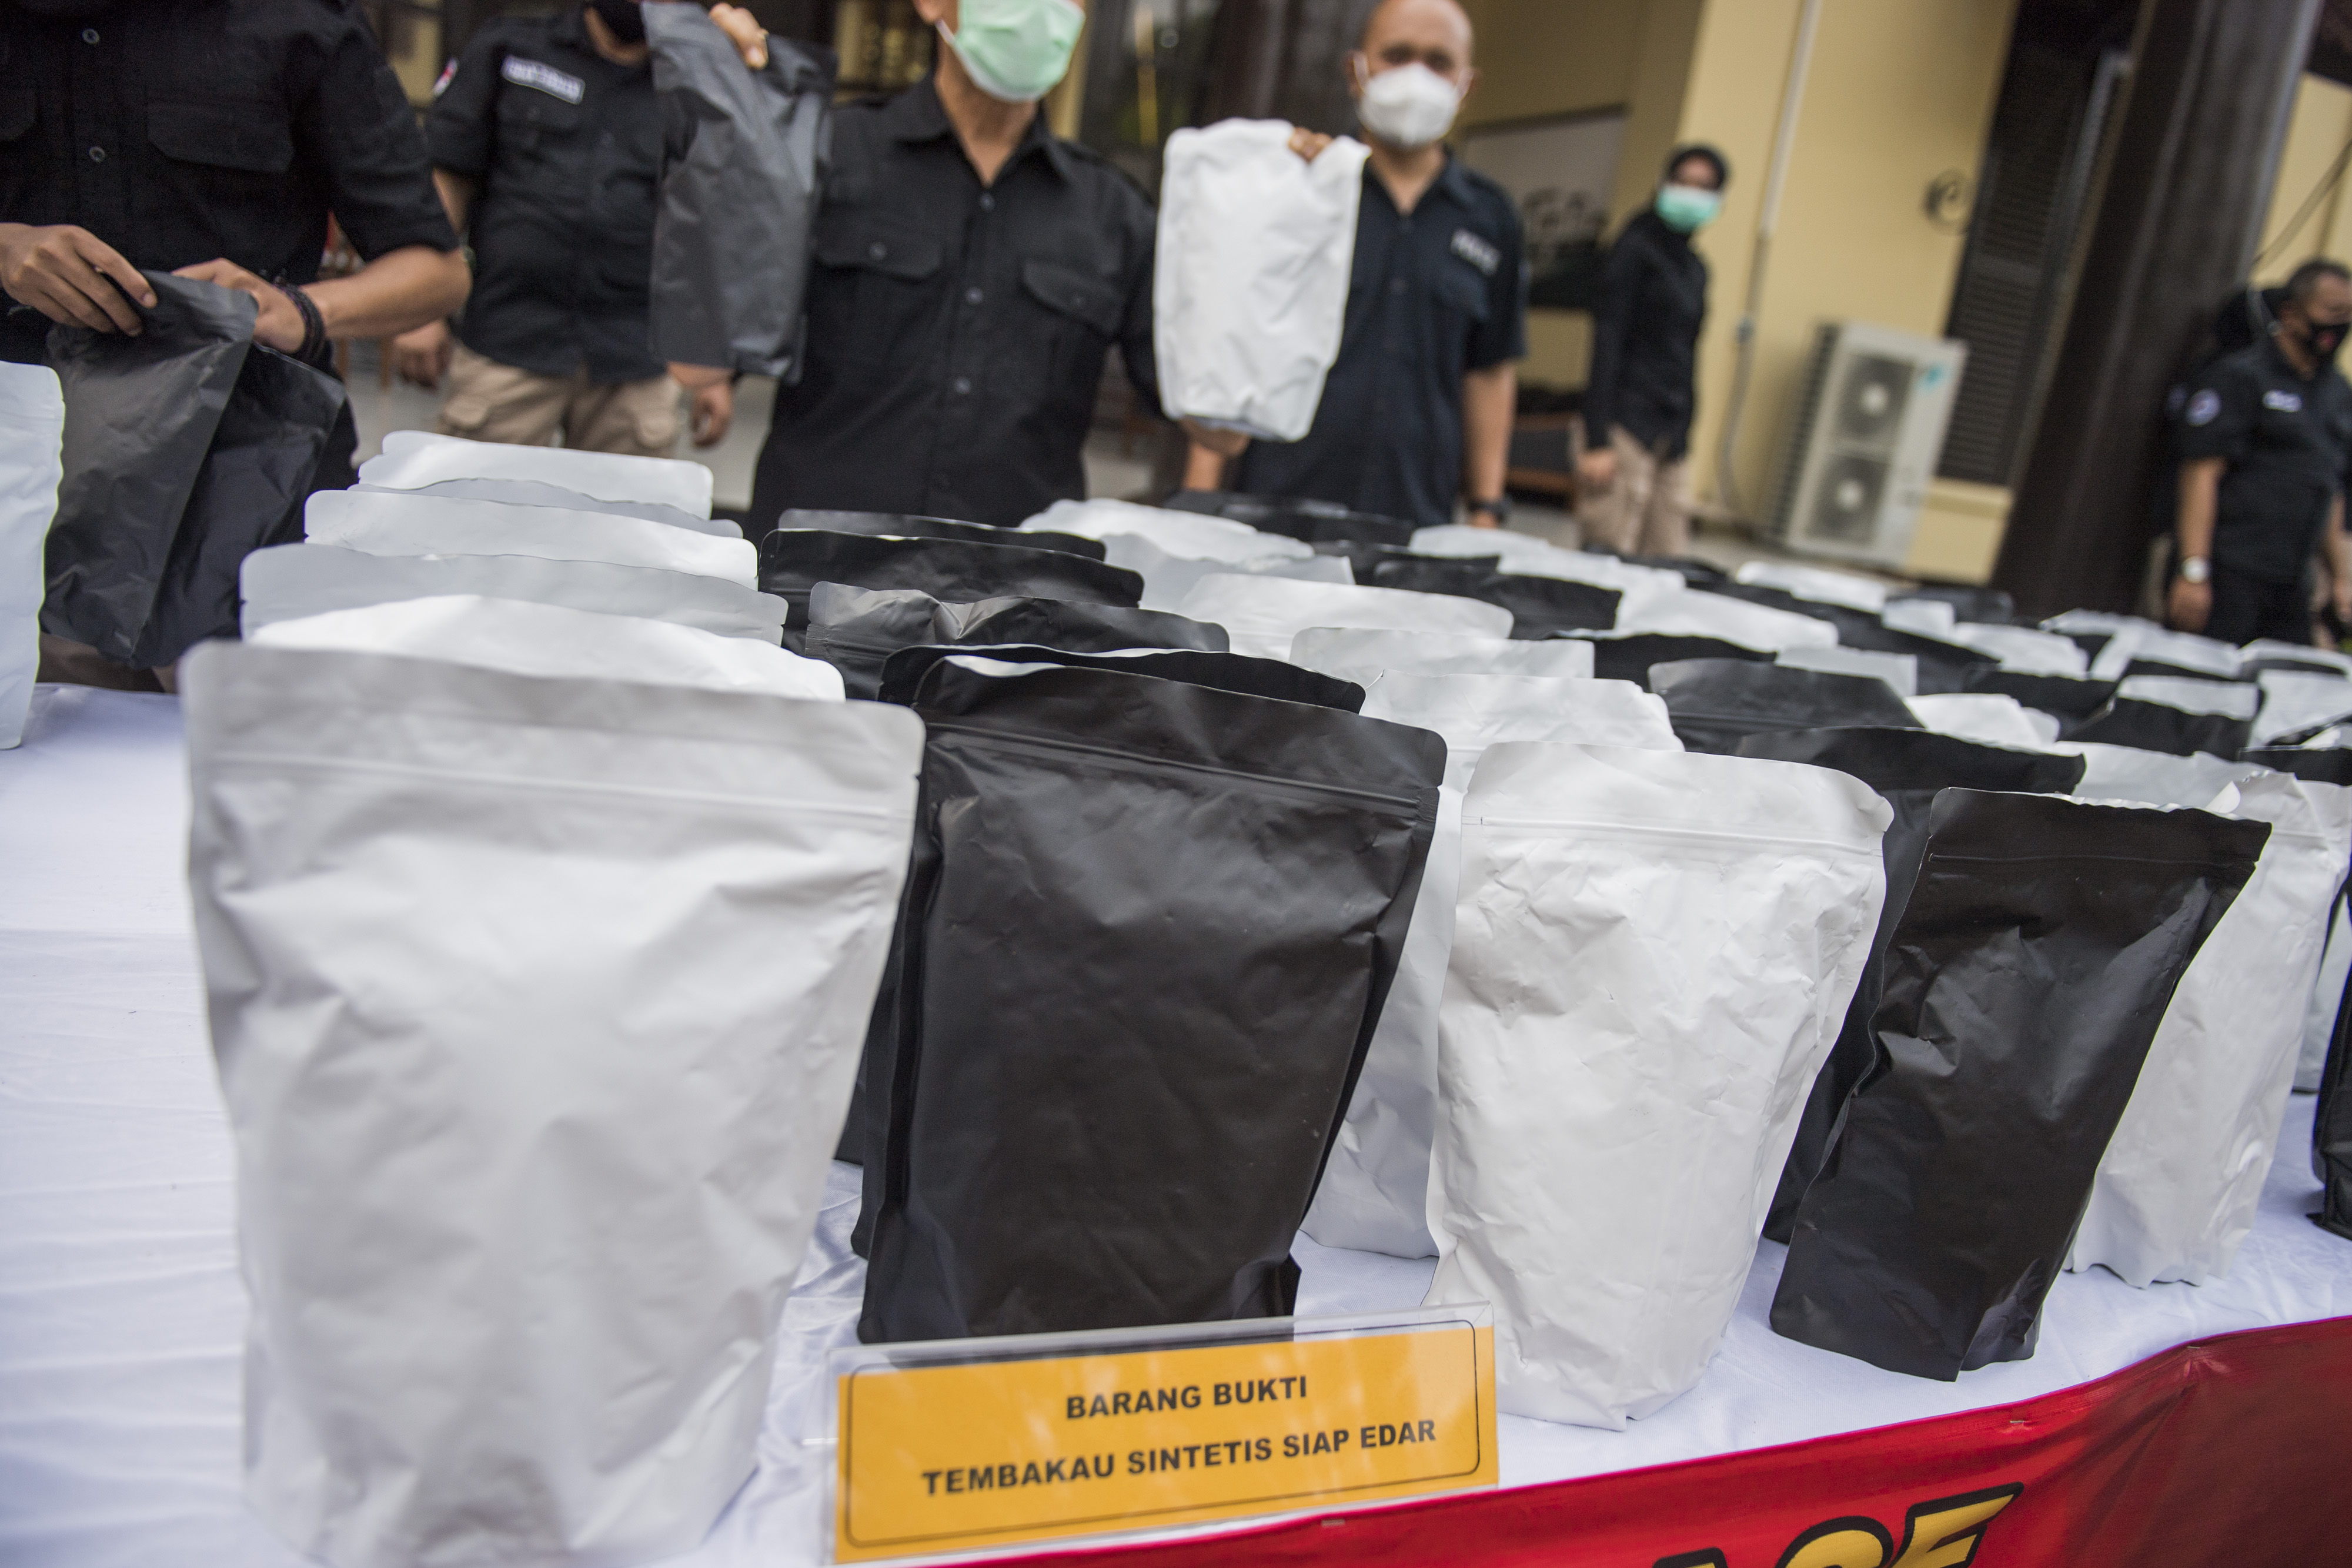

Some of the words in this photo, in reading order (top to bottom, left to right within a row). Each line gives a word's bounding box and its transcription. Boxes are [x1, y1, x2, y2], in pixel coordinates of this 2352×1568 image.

[1065, 1382, 1202, 1420] BARANG
[1212, 1375, 1308, 1407] BUKTI
[921, 1453, 1115, 1496] TEMBAKAU
[1127, 1434, 1273, 1476] SINTETIS
[1282, 1428, 1351, 1459] SIAP
[1359, 1419, 1436, 1450] EDAR
